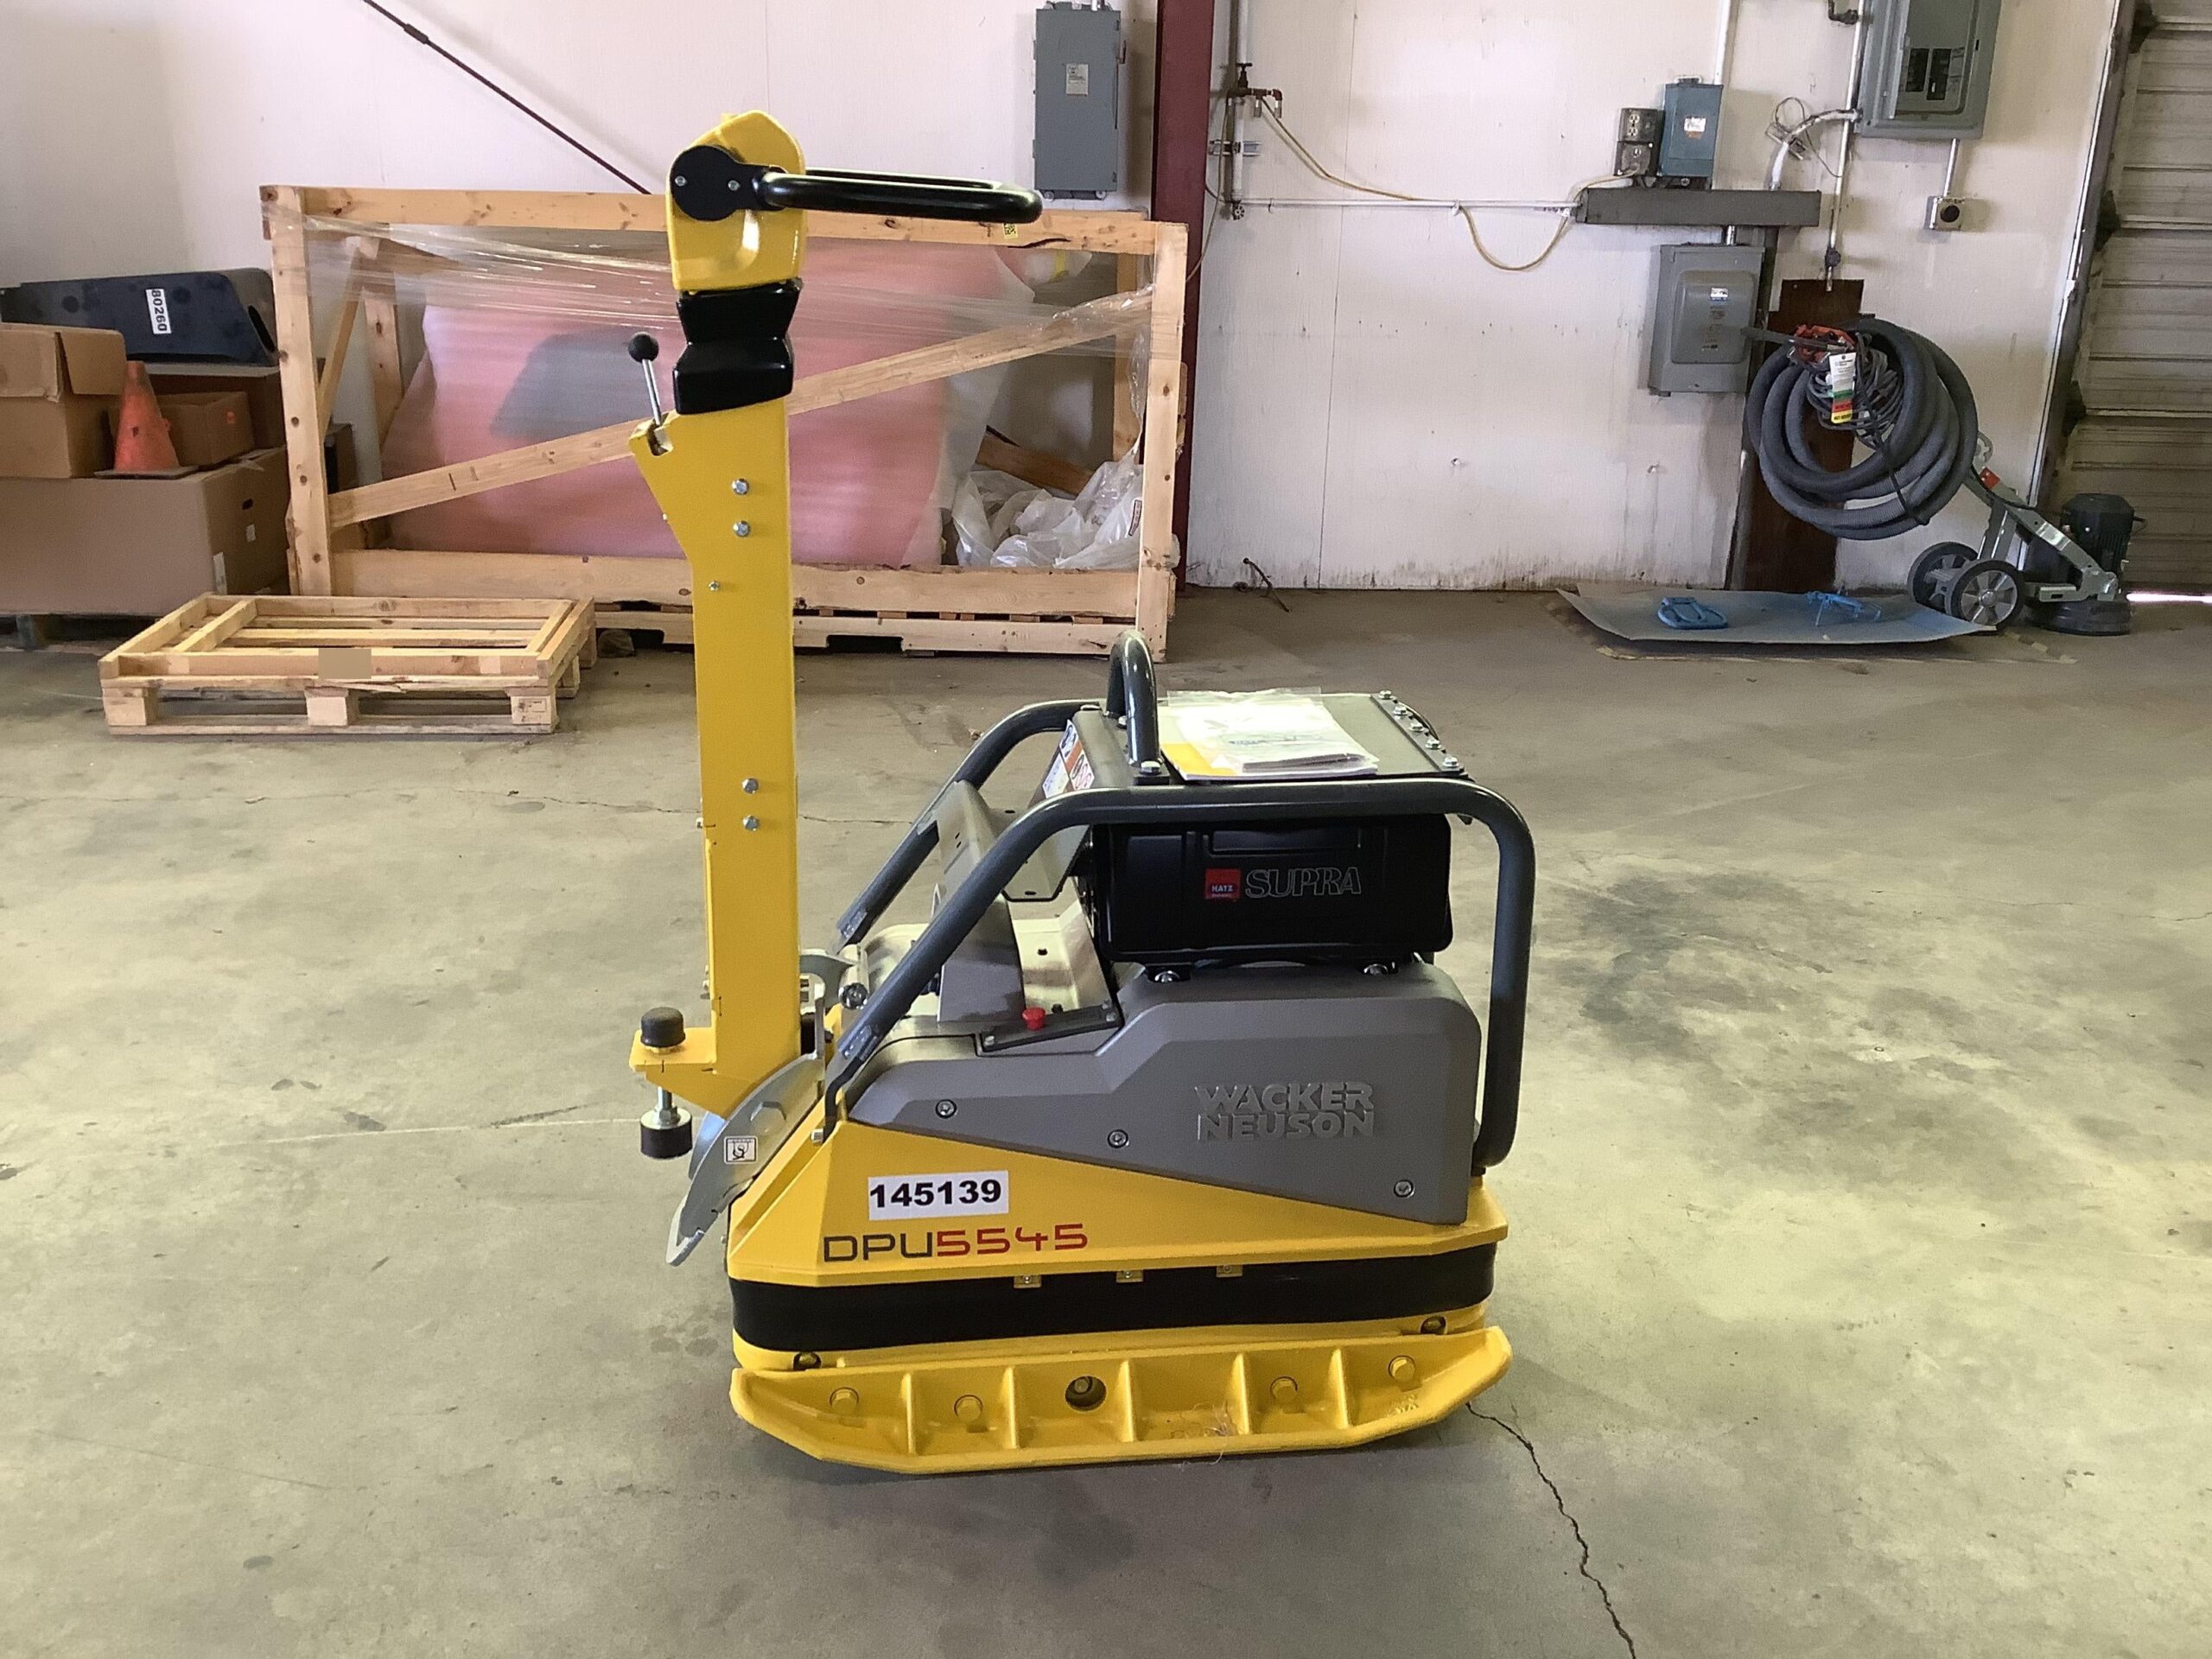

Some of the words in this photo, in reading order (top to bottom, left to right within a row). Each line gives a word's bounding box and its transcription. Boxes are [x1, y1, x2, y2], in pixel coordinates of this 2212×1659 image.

[151, 289, 167, 332] 80260
[1246, 868, 1362, 898] SUPRA
[1195, 1084, 1374, 1111] WACKER
[1198, 1111, 1375, 1141] NEUSON
[869, 1179, 1001, 1208] 145139
[823, 1224, 1088, 1262] DPU5545
